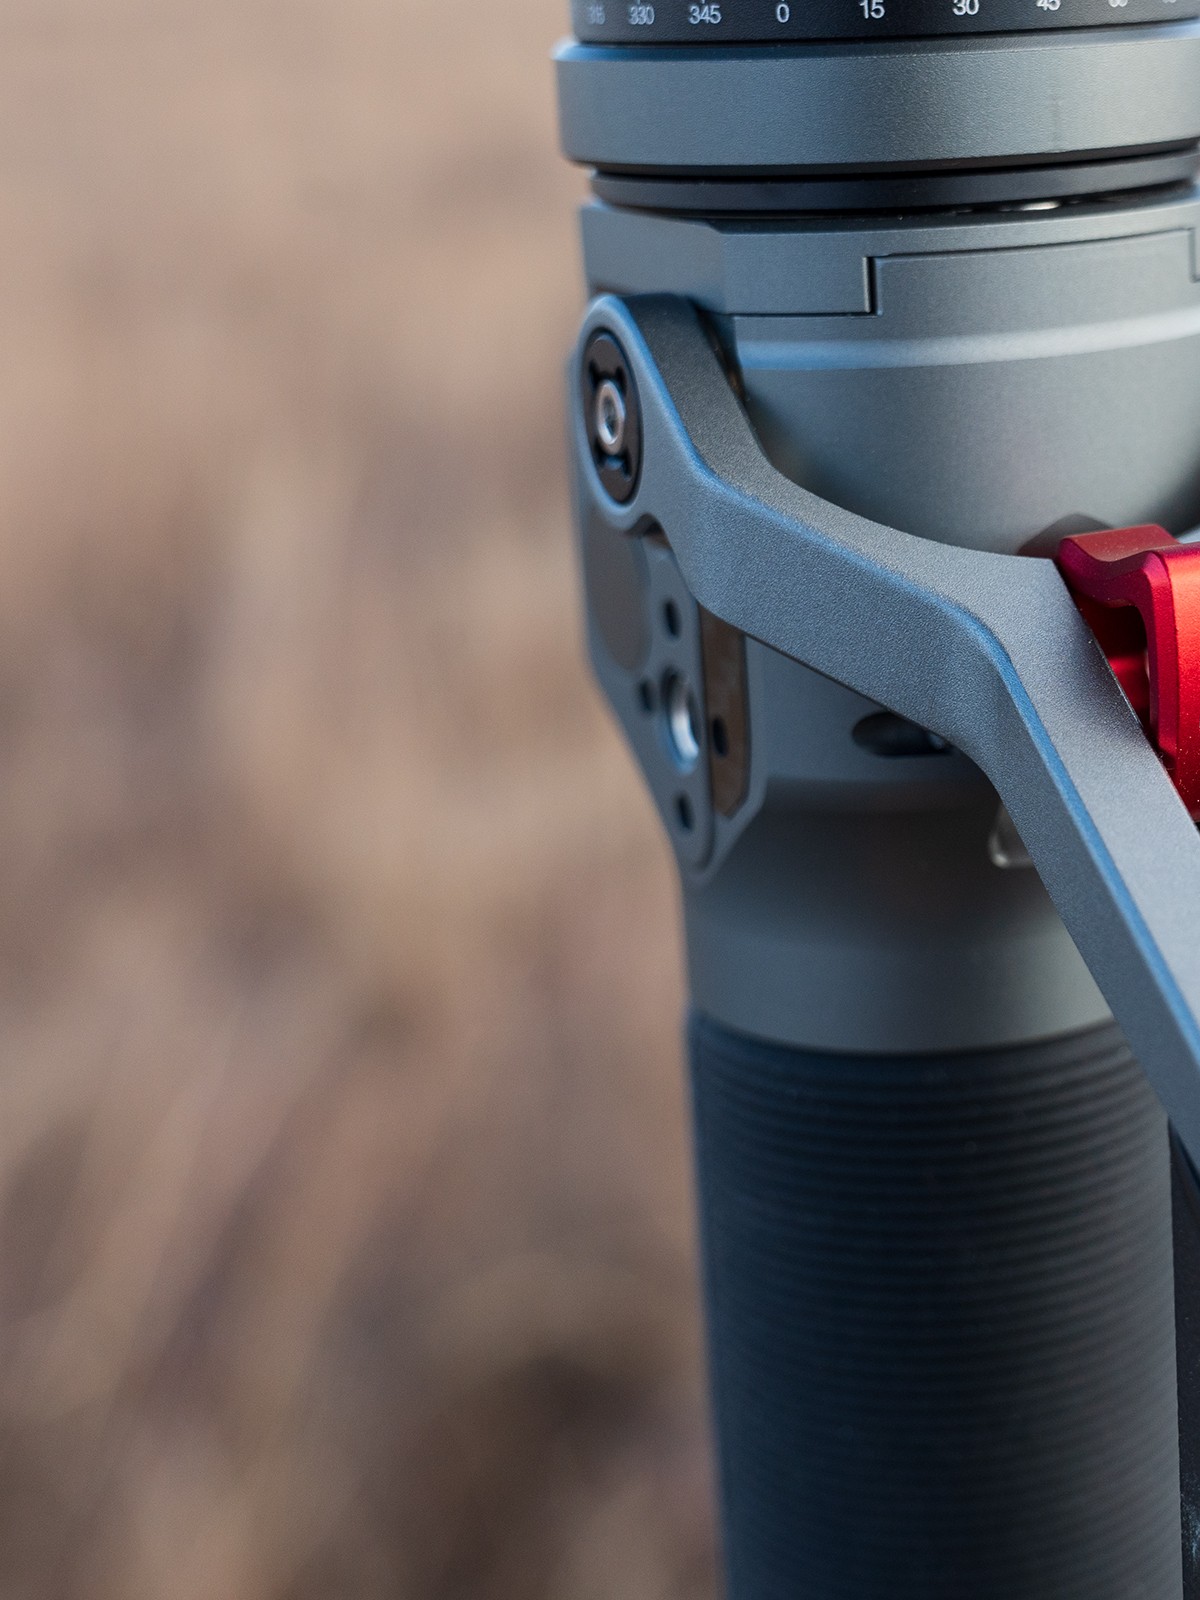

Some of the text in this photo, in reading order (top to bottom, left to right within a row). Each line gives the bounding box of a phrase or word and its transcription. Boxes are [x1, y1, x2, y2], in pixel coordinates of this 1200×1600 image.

[629, 5, 655, 25] 330
[688, 5, 722, 24] 345
[776, 4, 790, 23] 0
[859, 0, 885, 19] 15
[952, 0, 980, 15] 30
